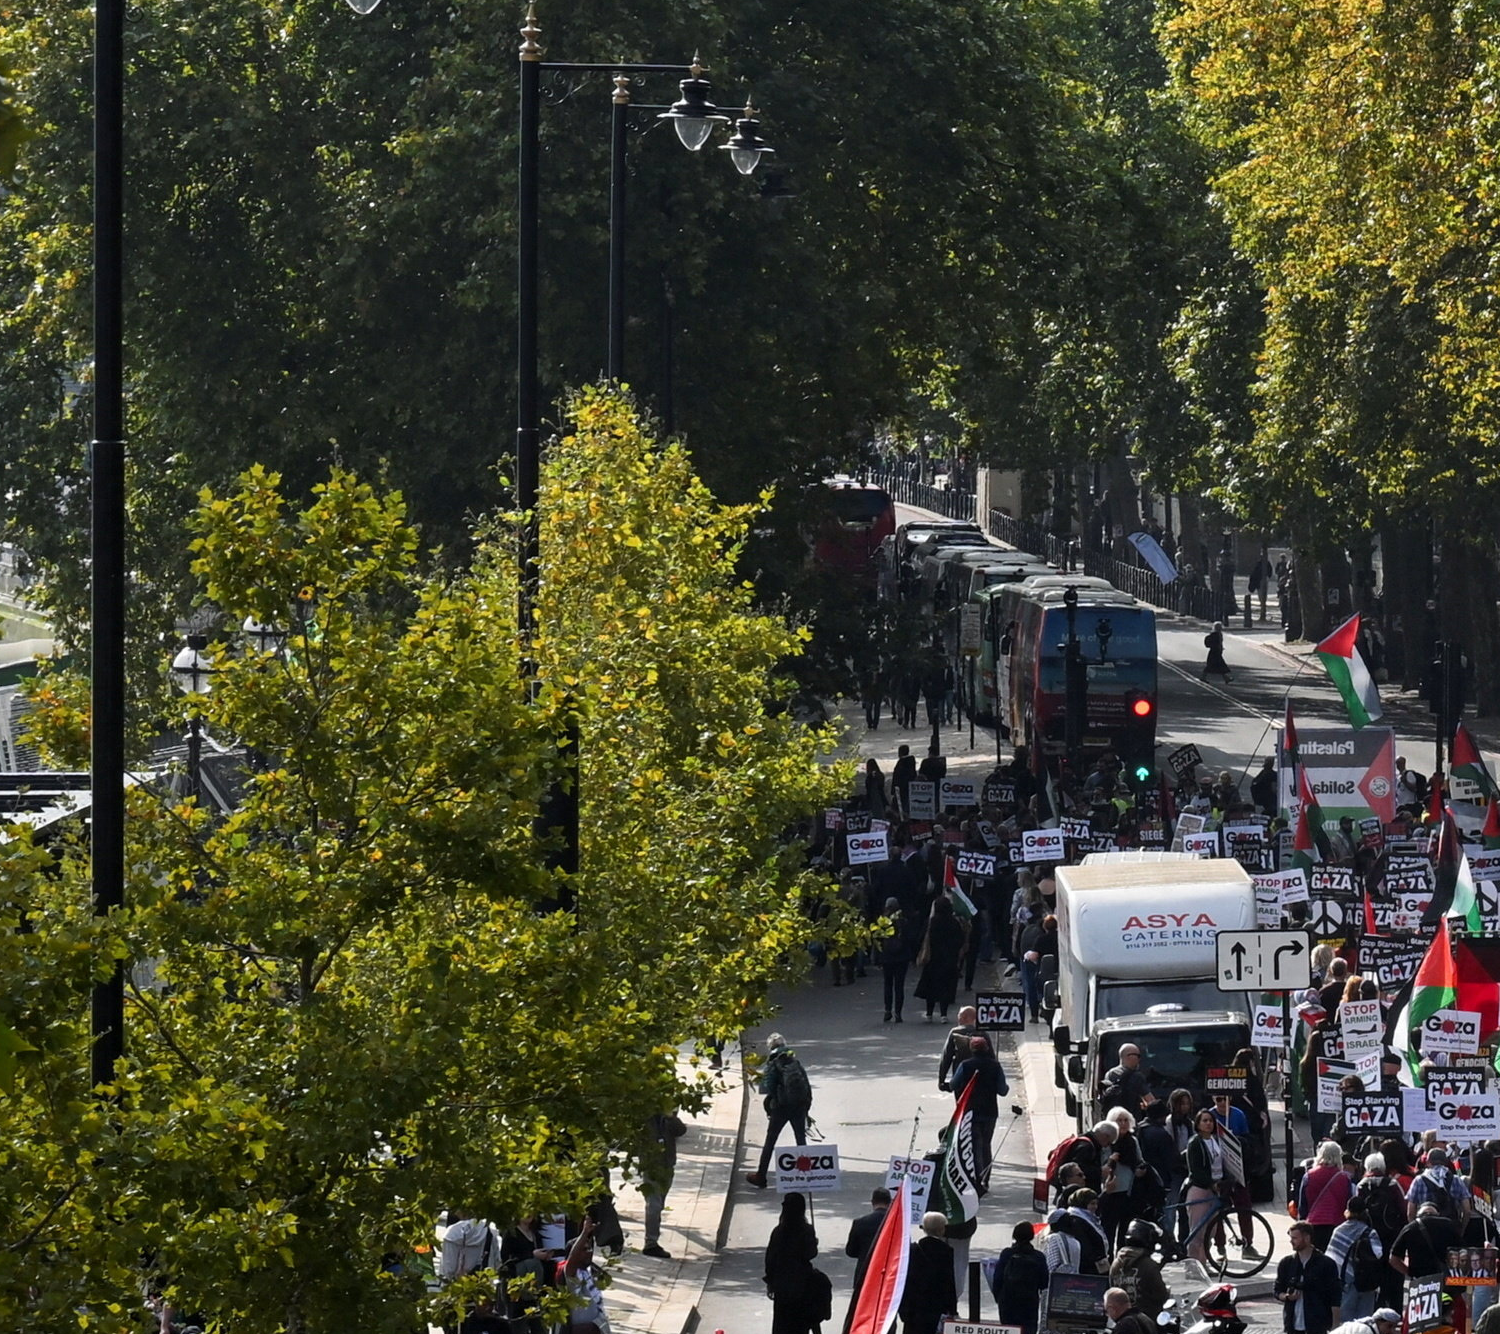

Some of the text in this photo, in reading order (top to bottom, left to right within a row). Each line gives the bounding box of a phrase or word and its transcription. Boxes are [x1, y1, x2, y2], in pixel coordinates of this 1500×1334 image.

[1122, 914, 1216, 930] ASYA
[1122, 930, 1217, 942] CATERING
[780, 1174, 794, 1183] Stop
[805, 1174, 838, 1183] genocide
[955, 1326, 973, 1334] RED
